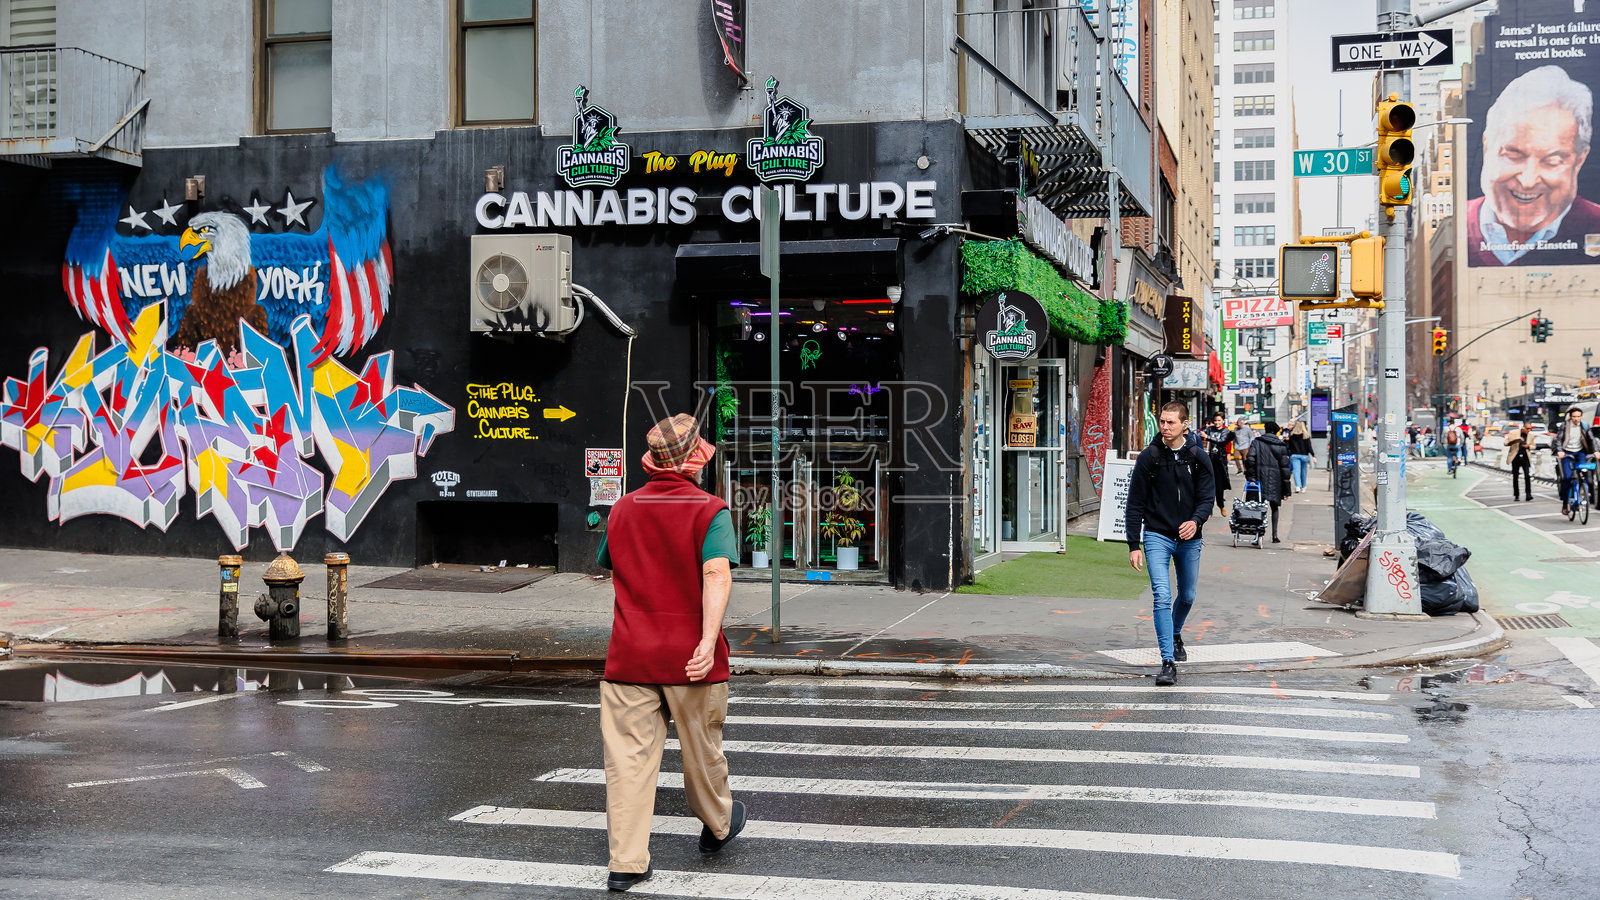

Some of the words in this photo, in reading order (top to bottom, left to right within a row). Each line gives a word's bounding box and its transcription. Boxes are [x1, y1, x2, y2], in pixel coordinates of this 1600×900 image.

[1499, 24, 1535, 36] James'
[1537, 23, 1565, 35] heart
[1567, 21, 1600, 32] failure
[1495, 36, 1536, 48] reversal
[1538, 37, 1548, 46] is
[1549, 37, 1570, 46] one
[1571, 34, 1588, 45] for
[1349, 45, 1383, 60] ONE
[1399, 41, 1435, 57] WAY
[1515, 48, 1550, 60] record
[1551, 47, 1586, 58] books.
[562, 149, 625, 168] CANNABIS
[752, 142, 818, 161] CANNABIS
[642, 150, 676, 174] The
[689, 150, 738, 177] Plug
[762, 158, 809, 170] CULTURE
[1298, 153, 1314, 174] W
[1323, 151, 1349, 173] 30
[1358, 150, 1370, 163] ST
[571, 164, 615, 177] CULTURE
[475, 187, 698, 228] CANNABIS
[721, 181, 937, 223] CULTURE
[1479, 240, 1535, 252] Montefiore
[1536, 239, 1578, 250] Einstein
[118, 261, 188, 299] NEW
[257, 260, 324, 305] YORK
[1182, 301, 1190, 324] THAI
[1226, 297, 1288, 319] PIZZA
[990, 334, 1032, 346] CANNABIS
[1182, 328, 1190, 350] FOOD
[996, 343, 1026, 352] CULTURE
[466, 383, 499, 400] THE
[1013, 422, 1033, 430] RAW
[1342, 424, 1352, 438] P
[1010, 433, 1034, 443] CLOSED
[430, 470, 461, 484] TOTEM
